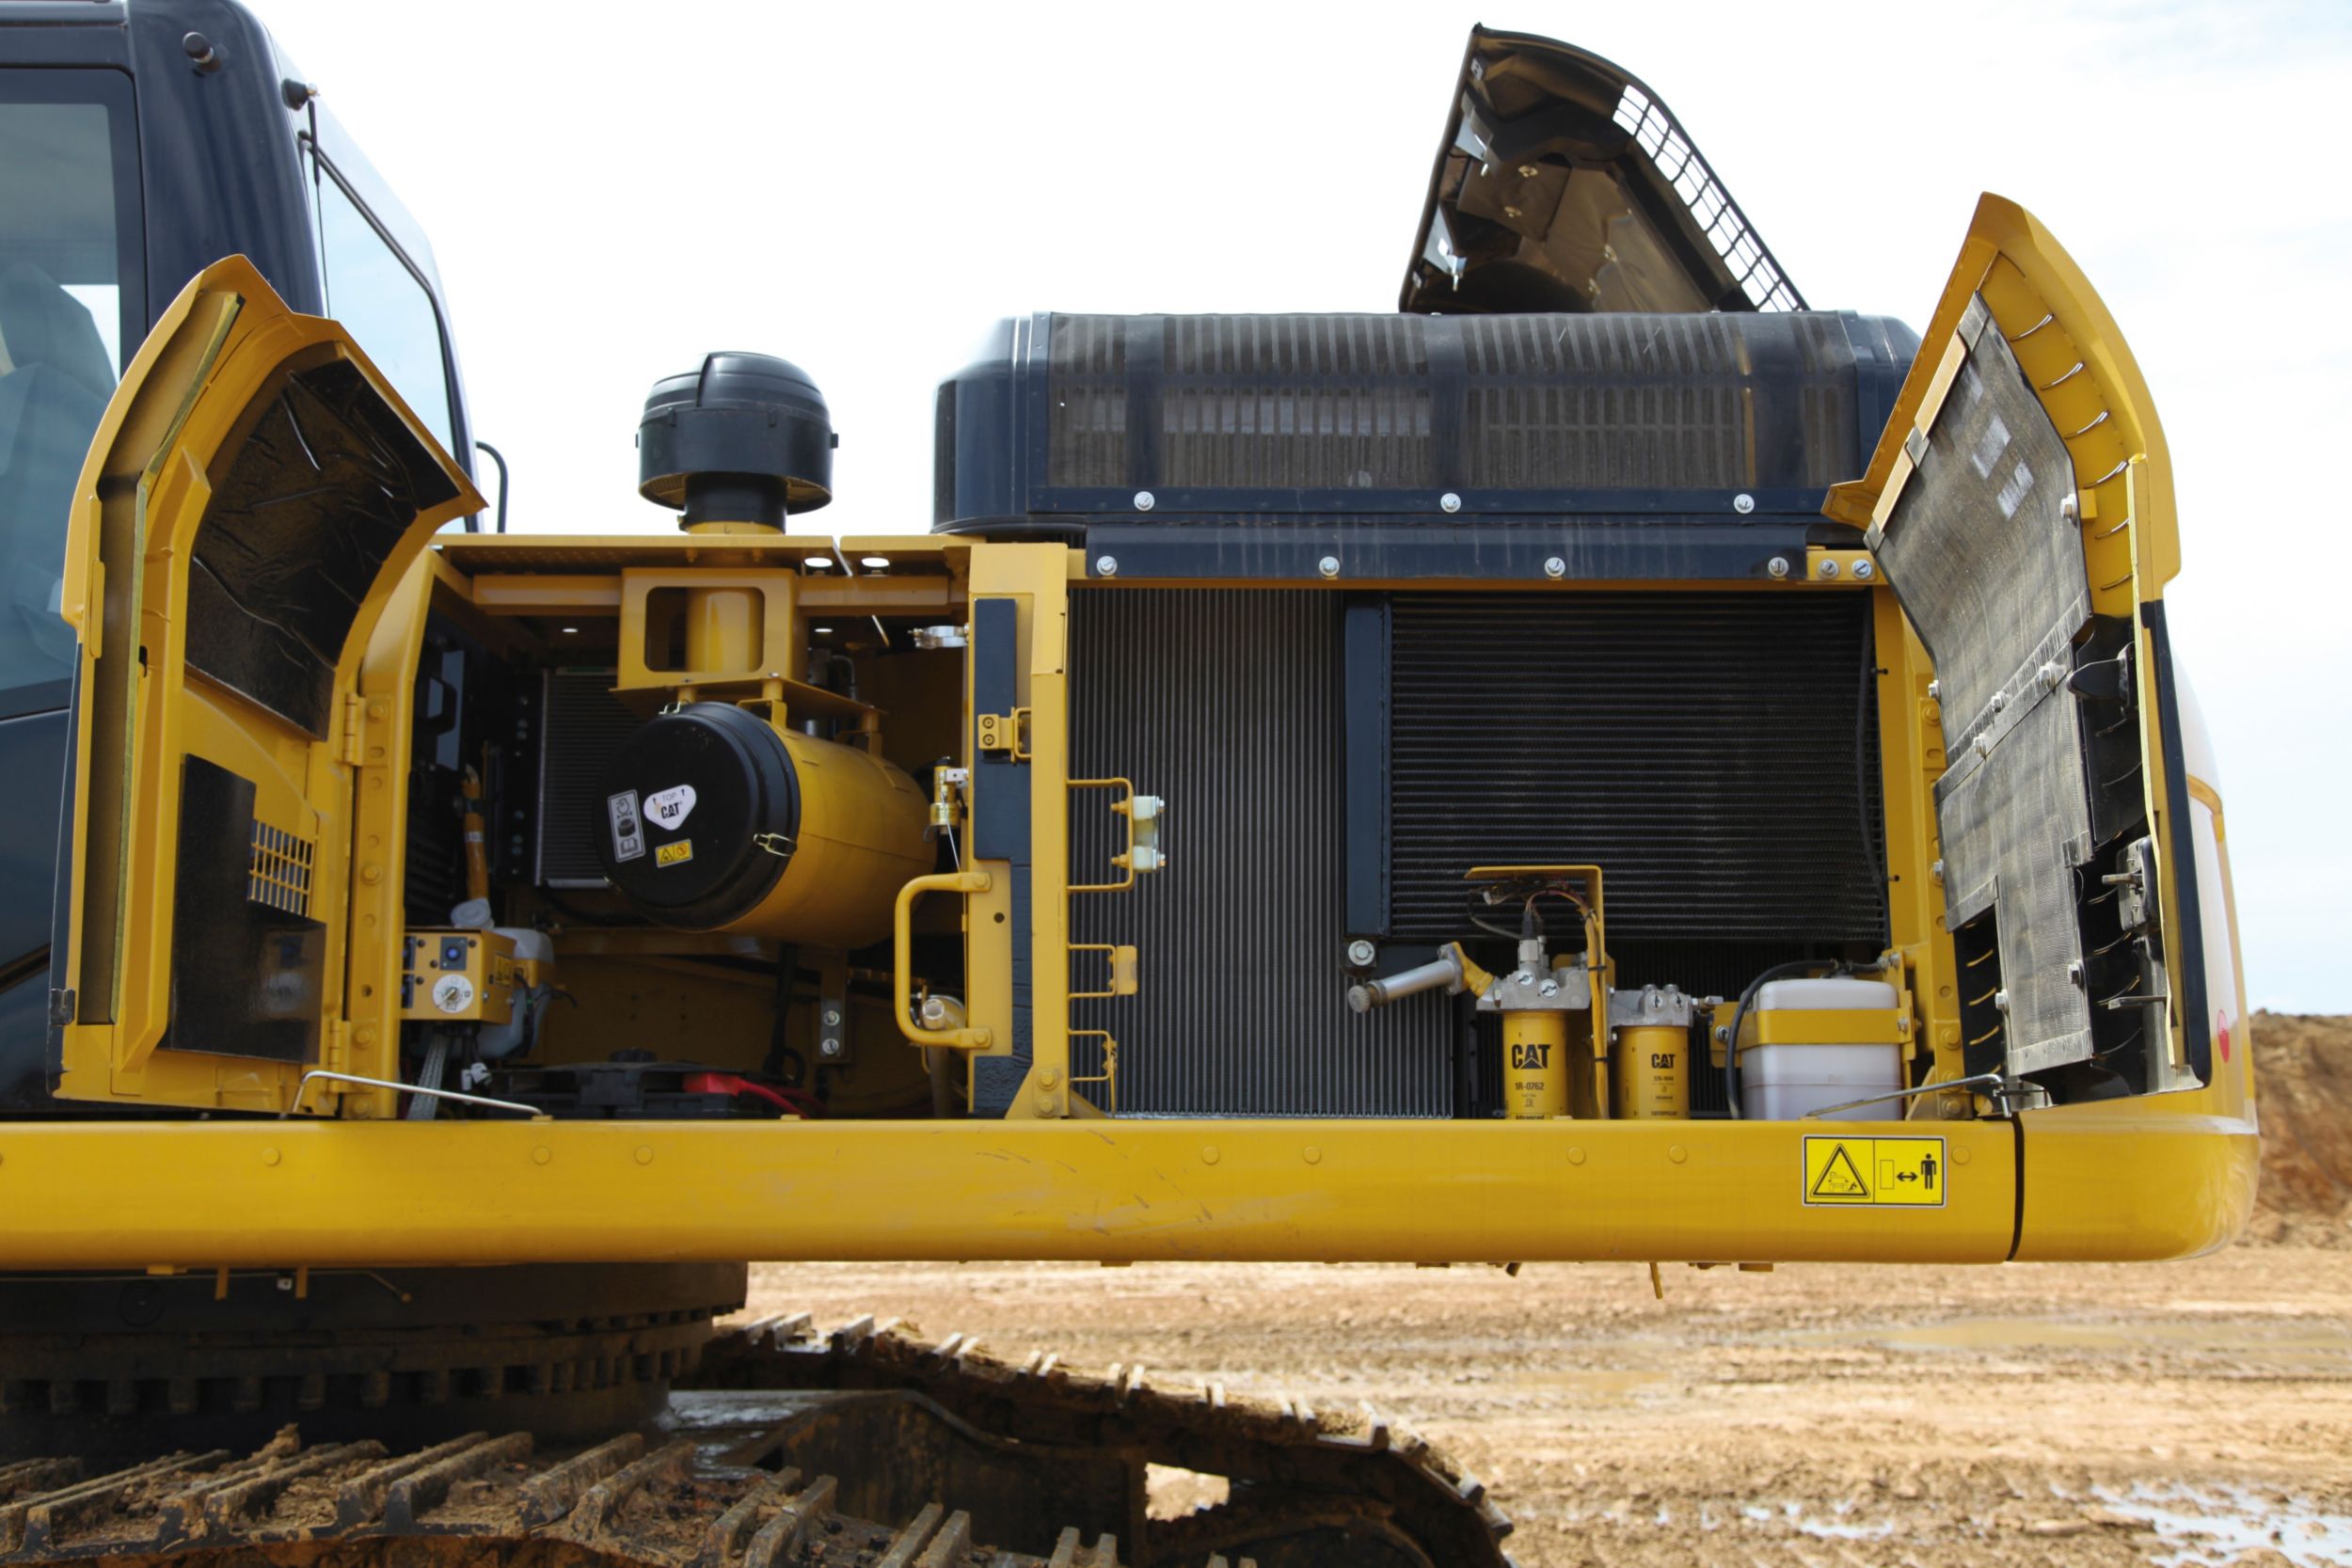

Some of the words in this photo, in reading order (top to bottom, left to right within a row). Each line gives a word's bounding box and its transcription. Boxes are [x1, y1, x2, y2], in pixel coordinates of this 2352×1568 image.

[661, 791, 677, 802] TOP
[660, 802, 680, 819] CAT
[1511, 1044, 1551, 1069] CAT
[1651, 1053, 1676, 1069] CAT
[1514, 1082, 1545, 1091] 1R-0762
